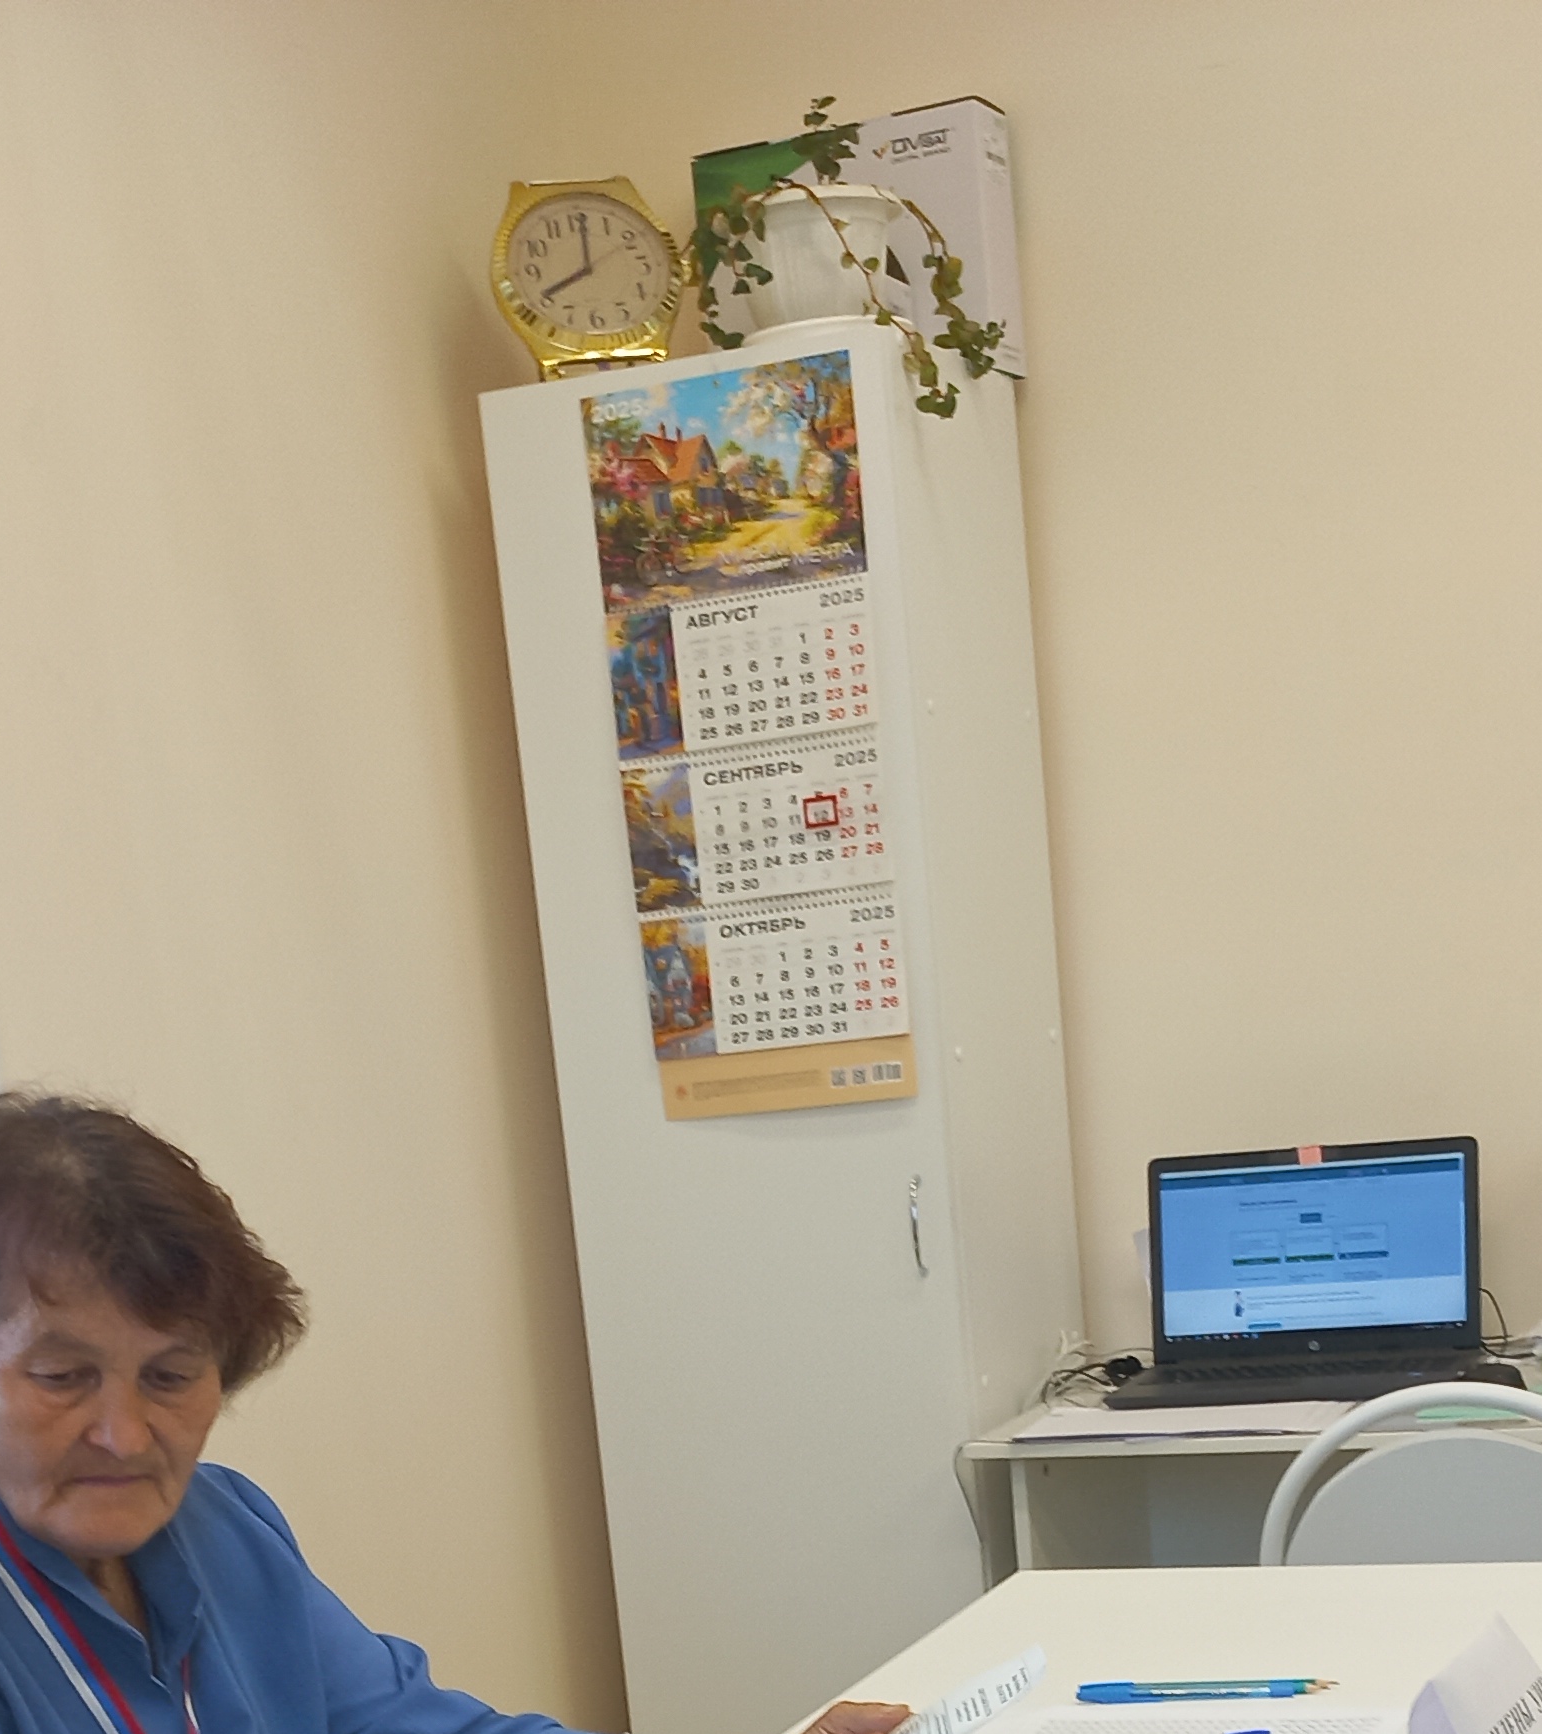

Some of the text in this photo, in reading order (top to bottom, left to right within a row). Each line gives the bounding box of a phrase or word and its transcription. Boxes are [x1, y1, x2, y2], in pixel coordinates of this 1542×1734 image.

[686, 588, 865, 630] АВГУСТ 2025
[702, 748, 877, 787] СЕНТЯБРЬ 2025
[719, 905, 896, 939] ОКТЯБРЬ 2025
